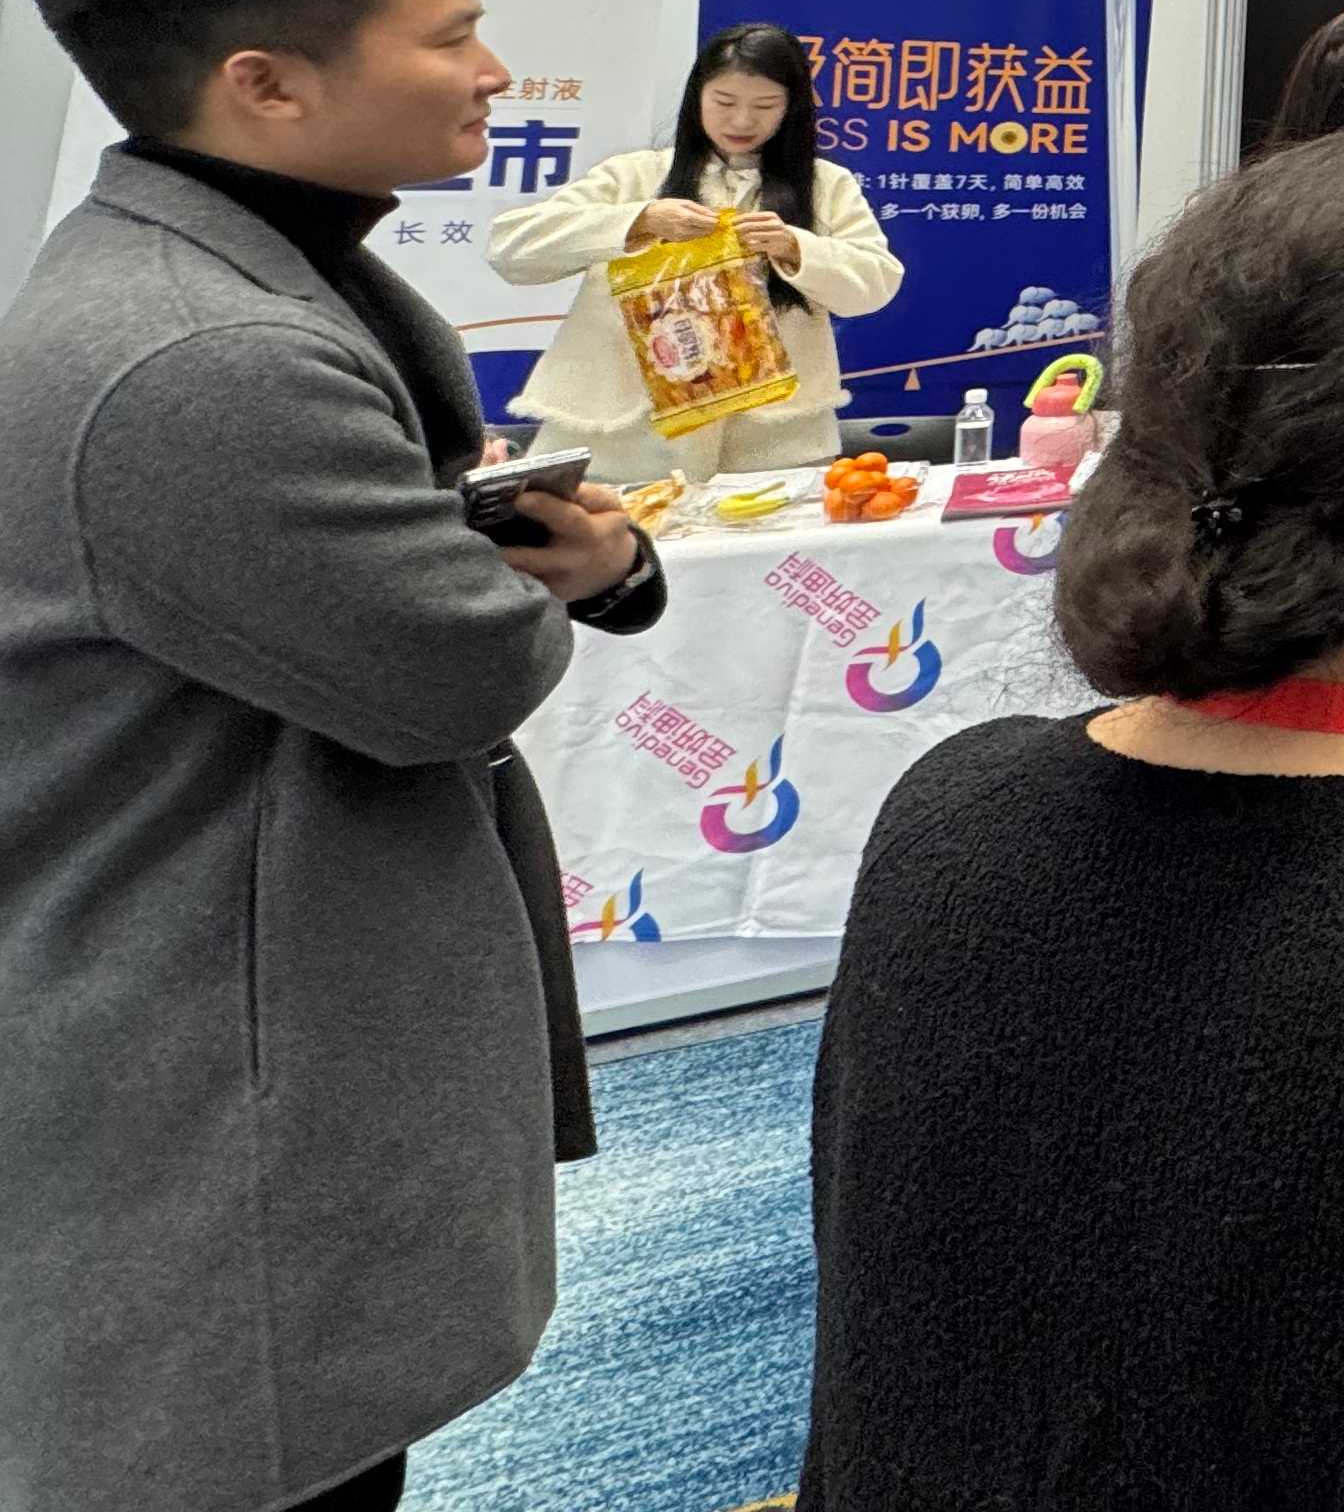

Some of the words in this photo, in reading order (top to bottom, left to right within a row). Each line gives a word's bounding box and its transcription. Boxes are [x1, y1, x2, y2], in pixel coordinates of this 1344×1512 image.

[814, 117, 870, 151] SS
[886, 120, 931, 152] IS
[948, 121, 1089, 155] MORE
